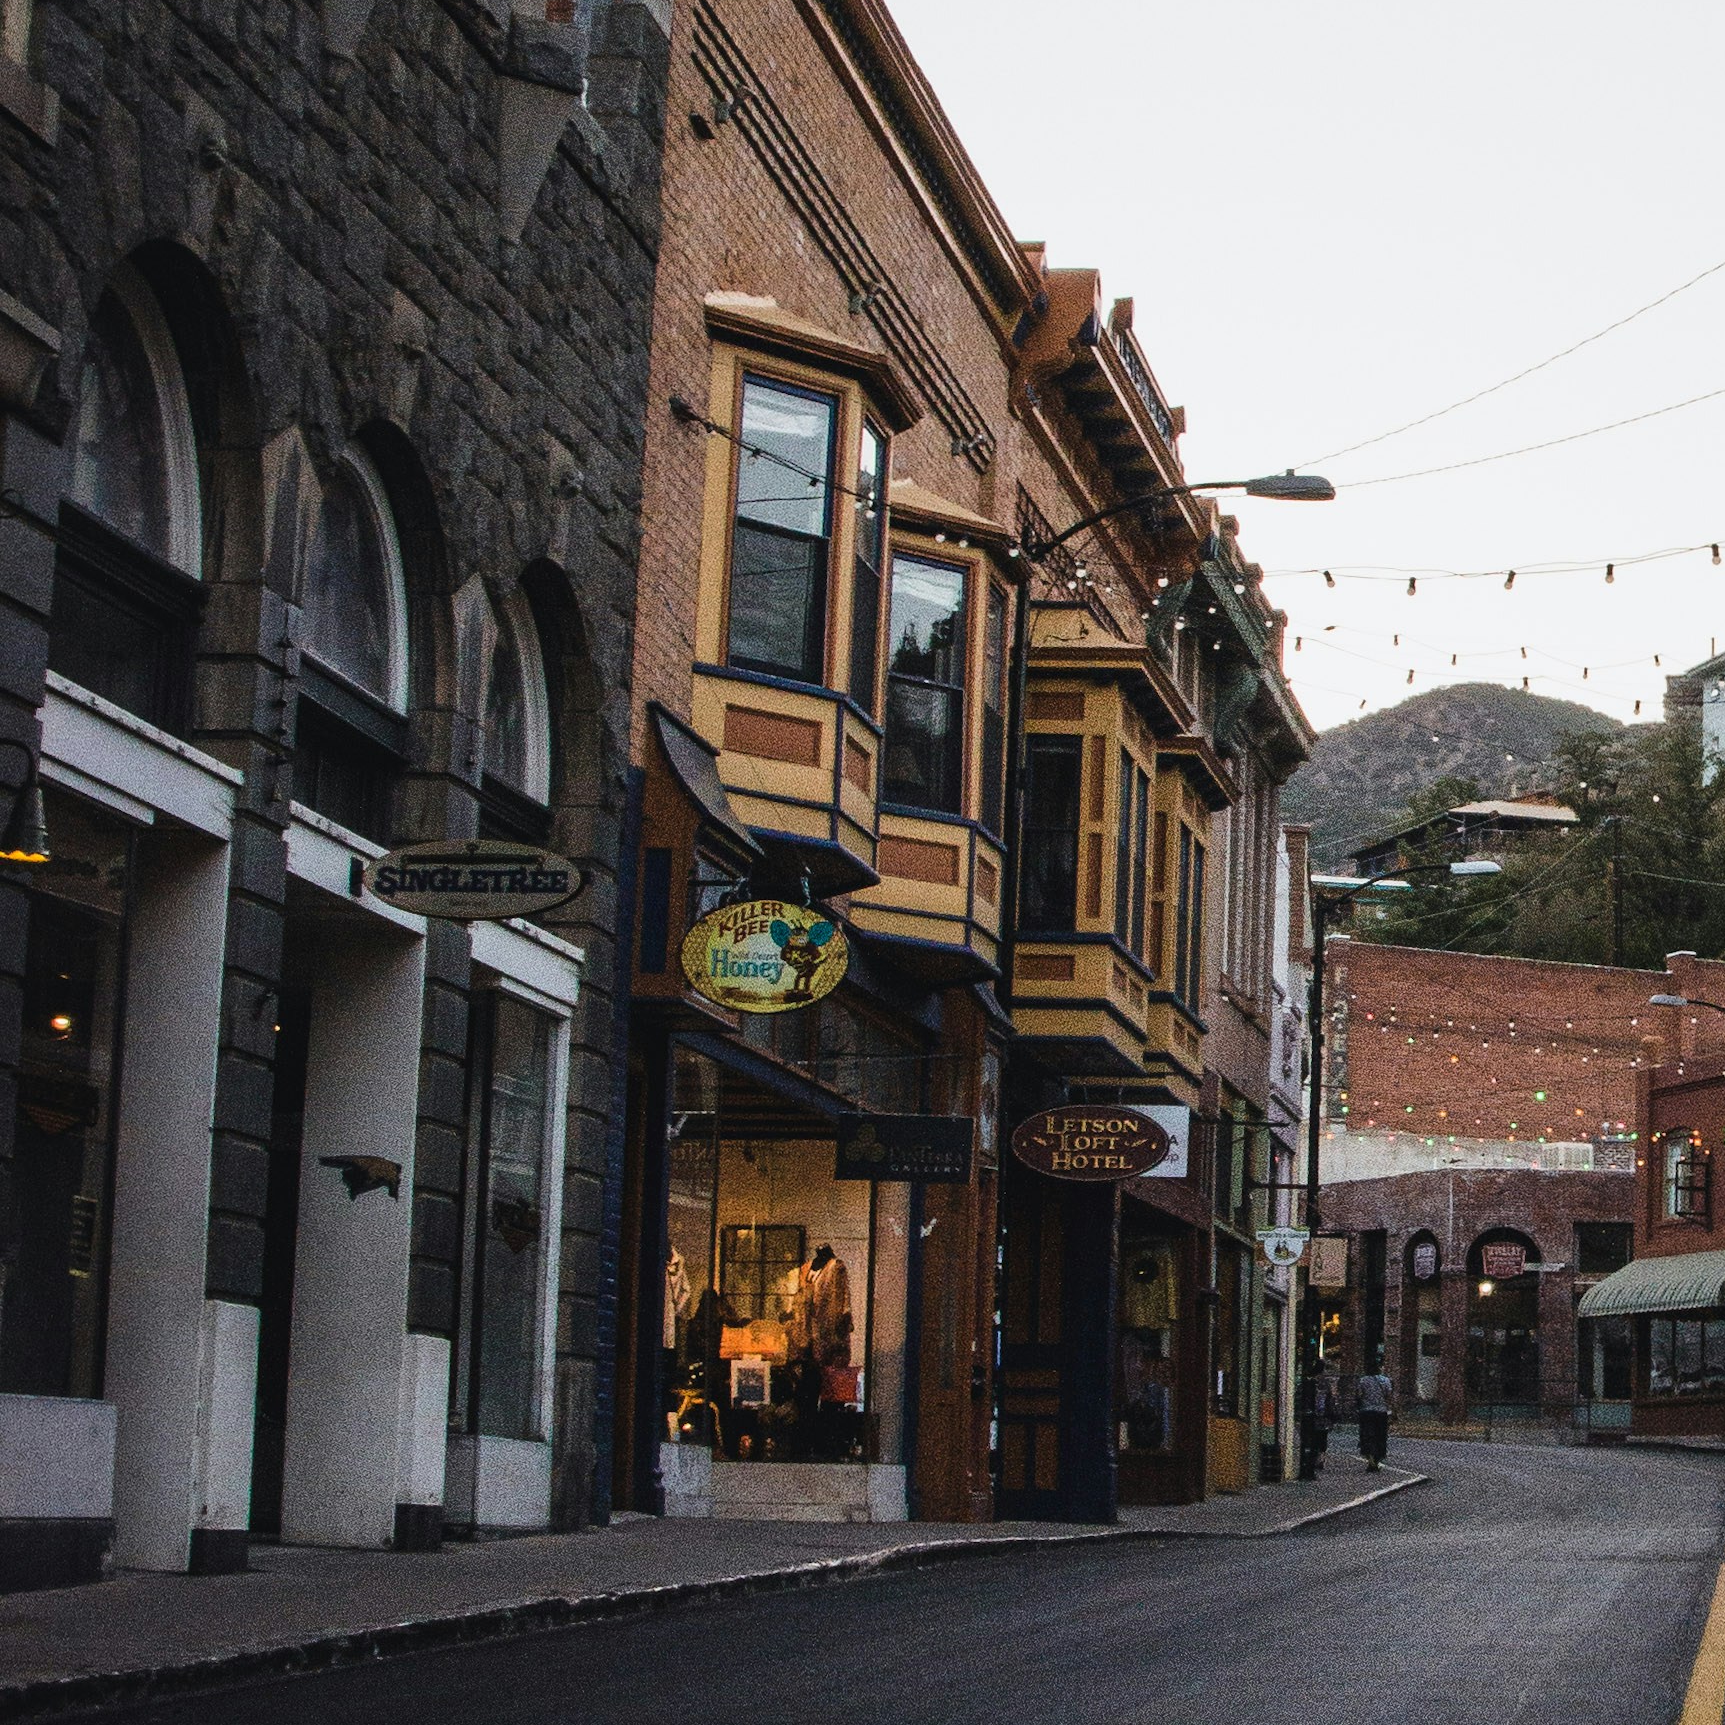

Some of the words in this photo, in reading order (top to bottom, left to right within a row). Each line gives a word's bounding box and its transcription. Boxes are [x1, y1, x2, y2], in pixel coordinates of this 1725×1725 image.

[375, 866, 568, 896] SINGLETREE
[719, 902, 786, 937] KILLER
[733, 920, 769, 944] BEE
[711, 948, 787, 984] Honey
[1045, 1115, 1140, 1135] LETSON
[1059, 1134, 1121, 1152] LOFT
[1051, 1151, 1135, 1171] HOTEL
